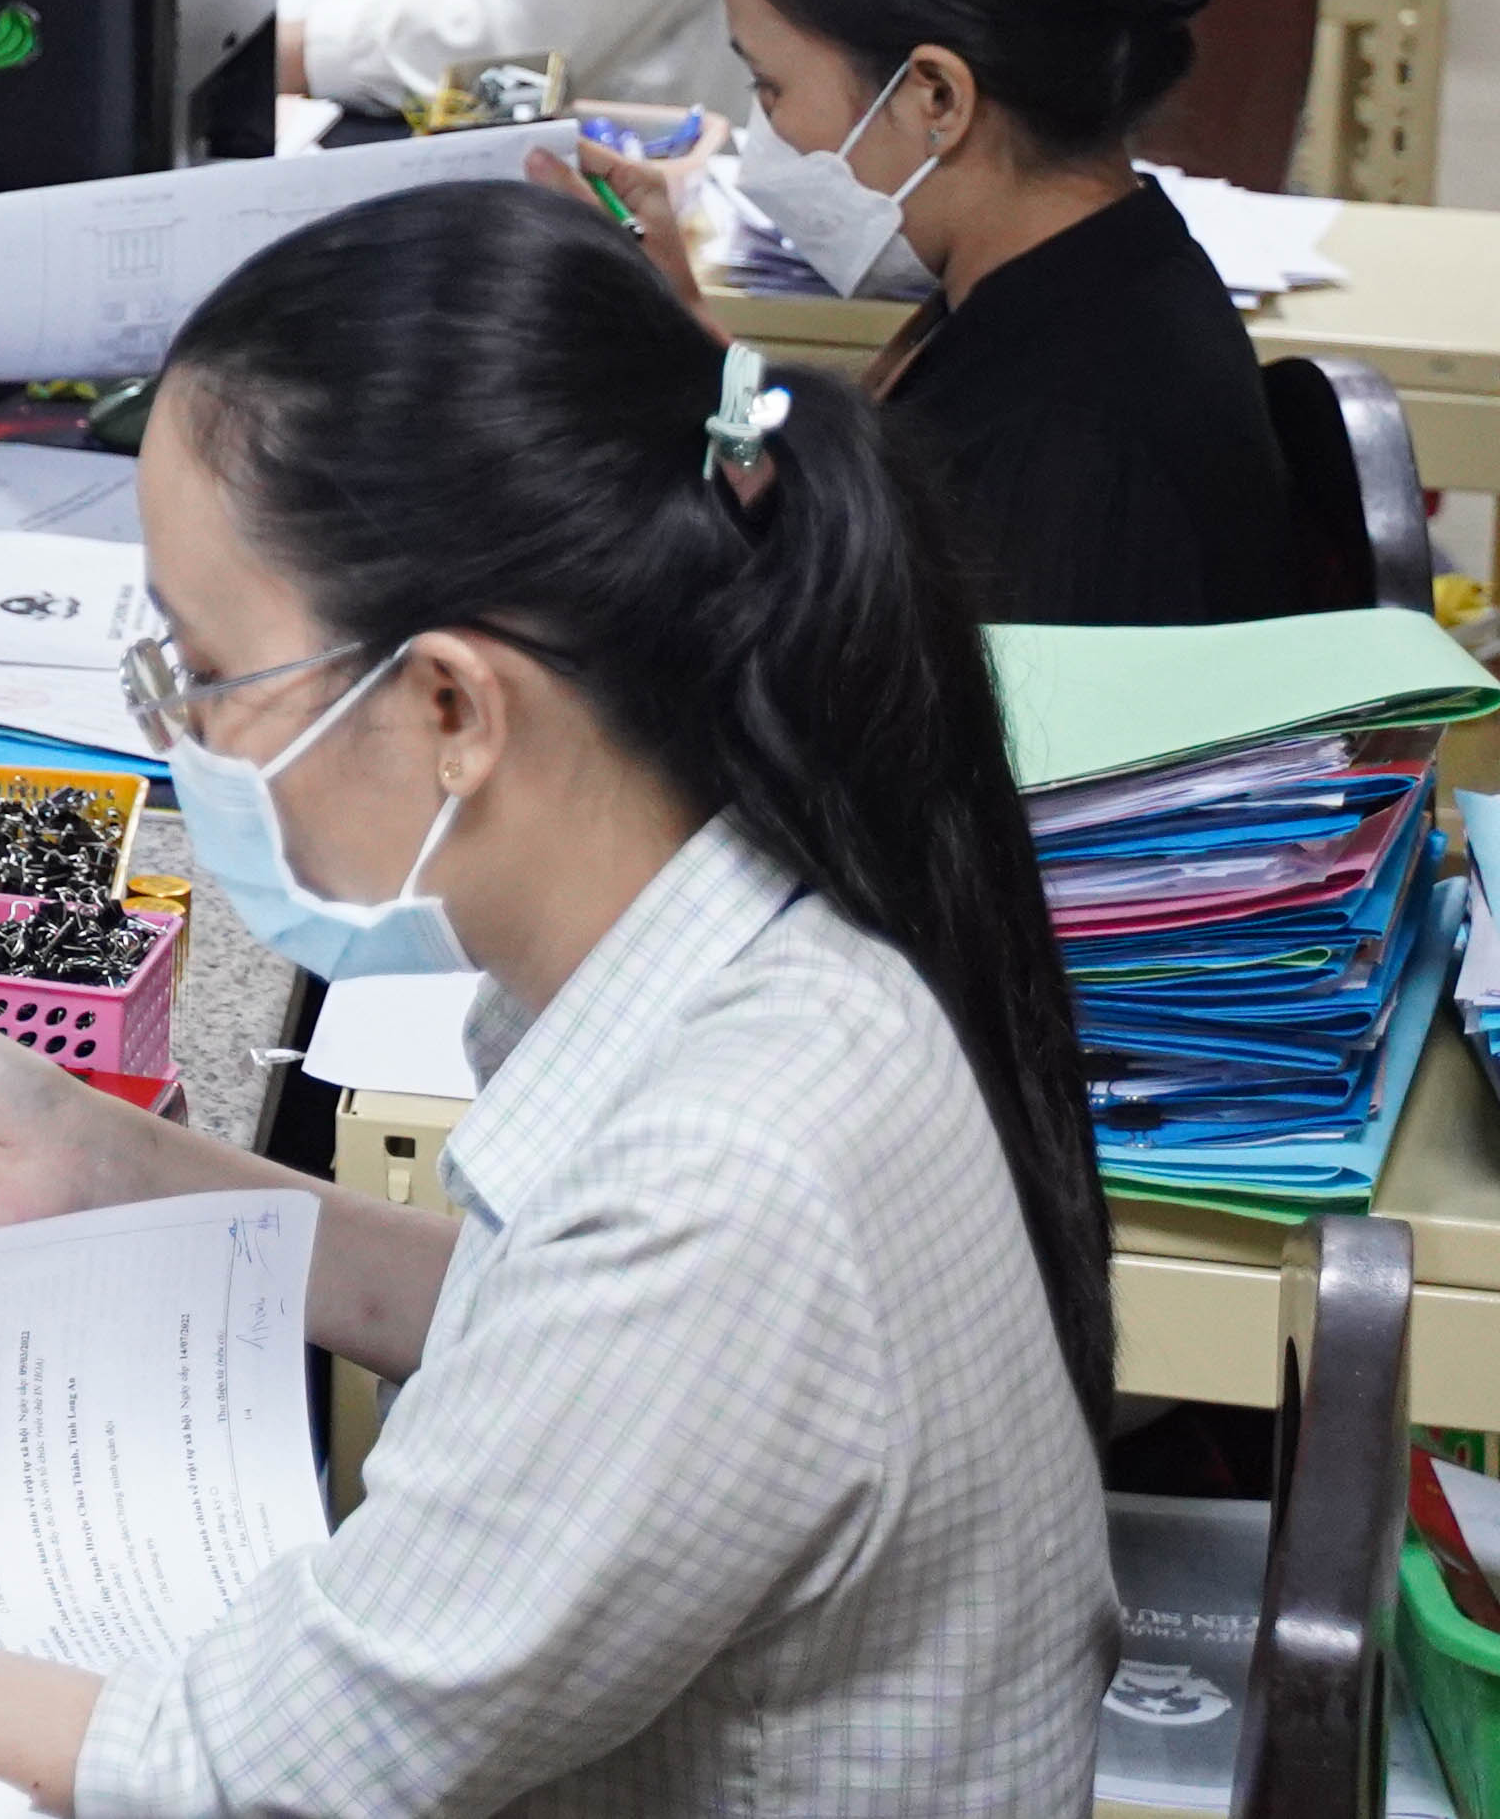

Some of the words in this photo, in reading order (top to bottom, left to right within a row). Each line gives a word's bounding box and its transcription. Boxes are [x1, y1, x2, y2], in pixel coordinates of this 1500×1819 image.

[179, 1313, 190, 1361] 14/07/2022
[67, 1377, 76, 1391] An
[67, 1393, 78, 1419] Long
[179, 1383, 190, 1410] Ngày
[180, 1414, 192, 1431] hội
[244, 1408, 253, 1420] 1/4
[19, 1427, 30, 1443] hội
[19, 1446, 30, 1458] xã
[184, 1461, 197, 1481] trật
[25, 1475, 34, 1494] trật
[75, 1489, 87, 1517] Châu
